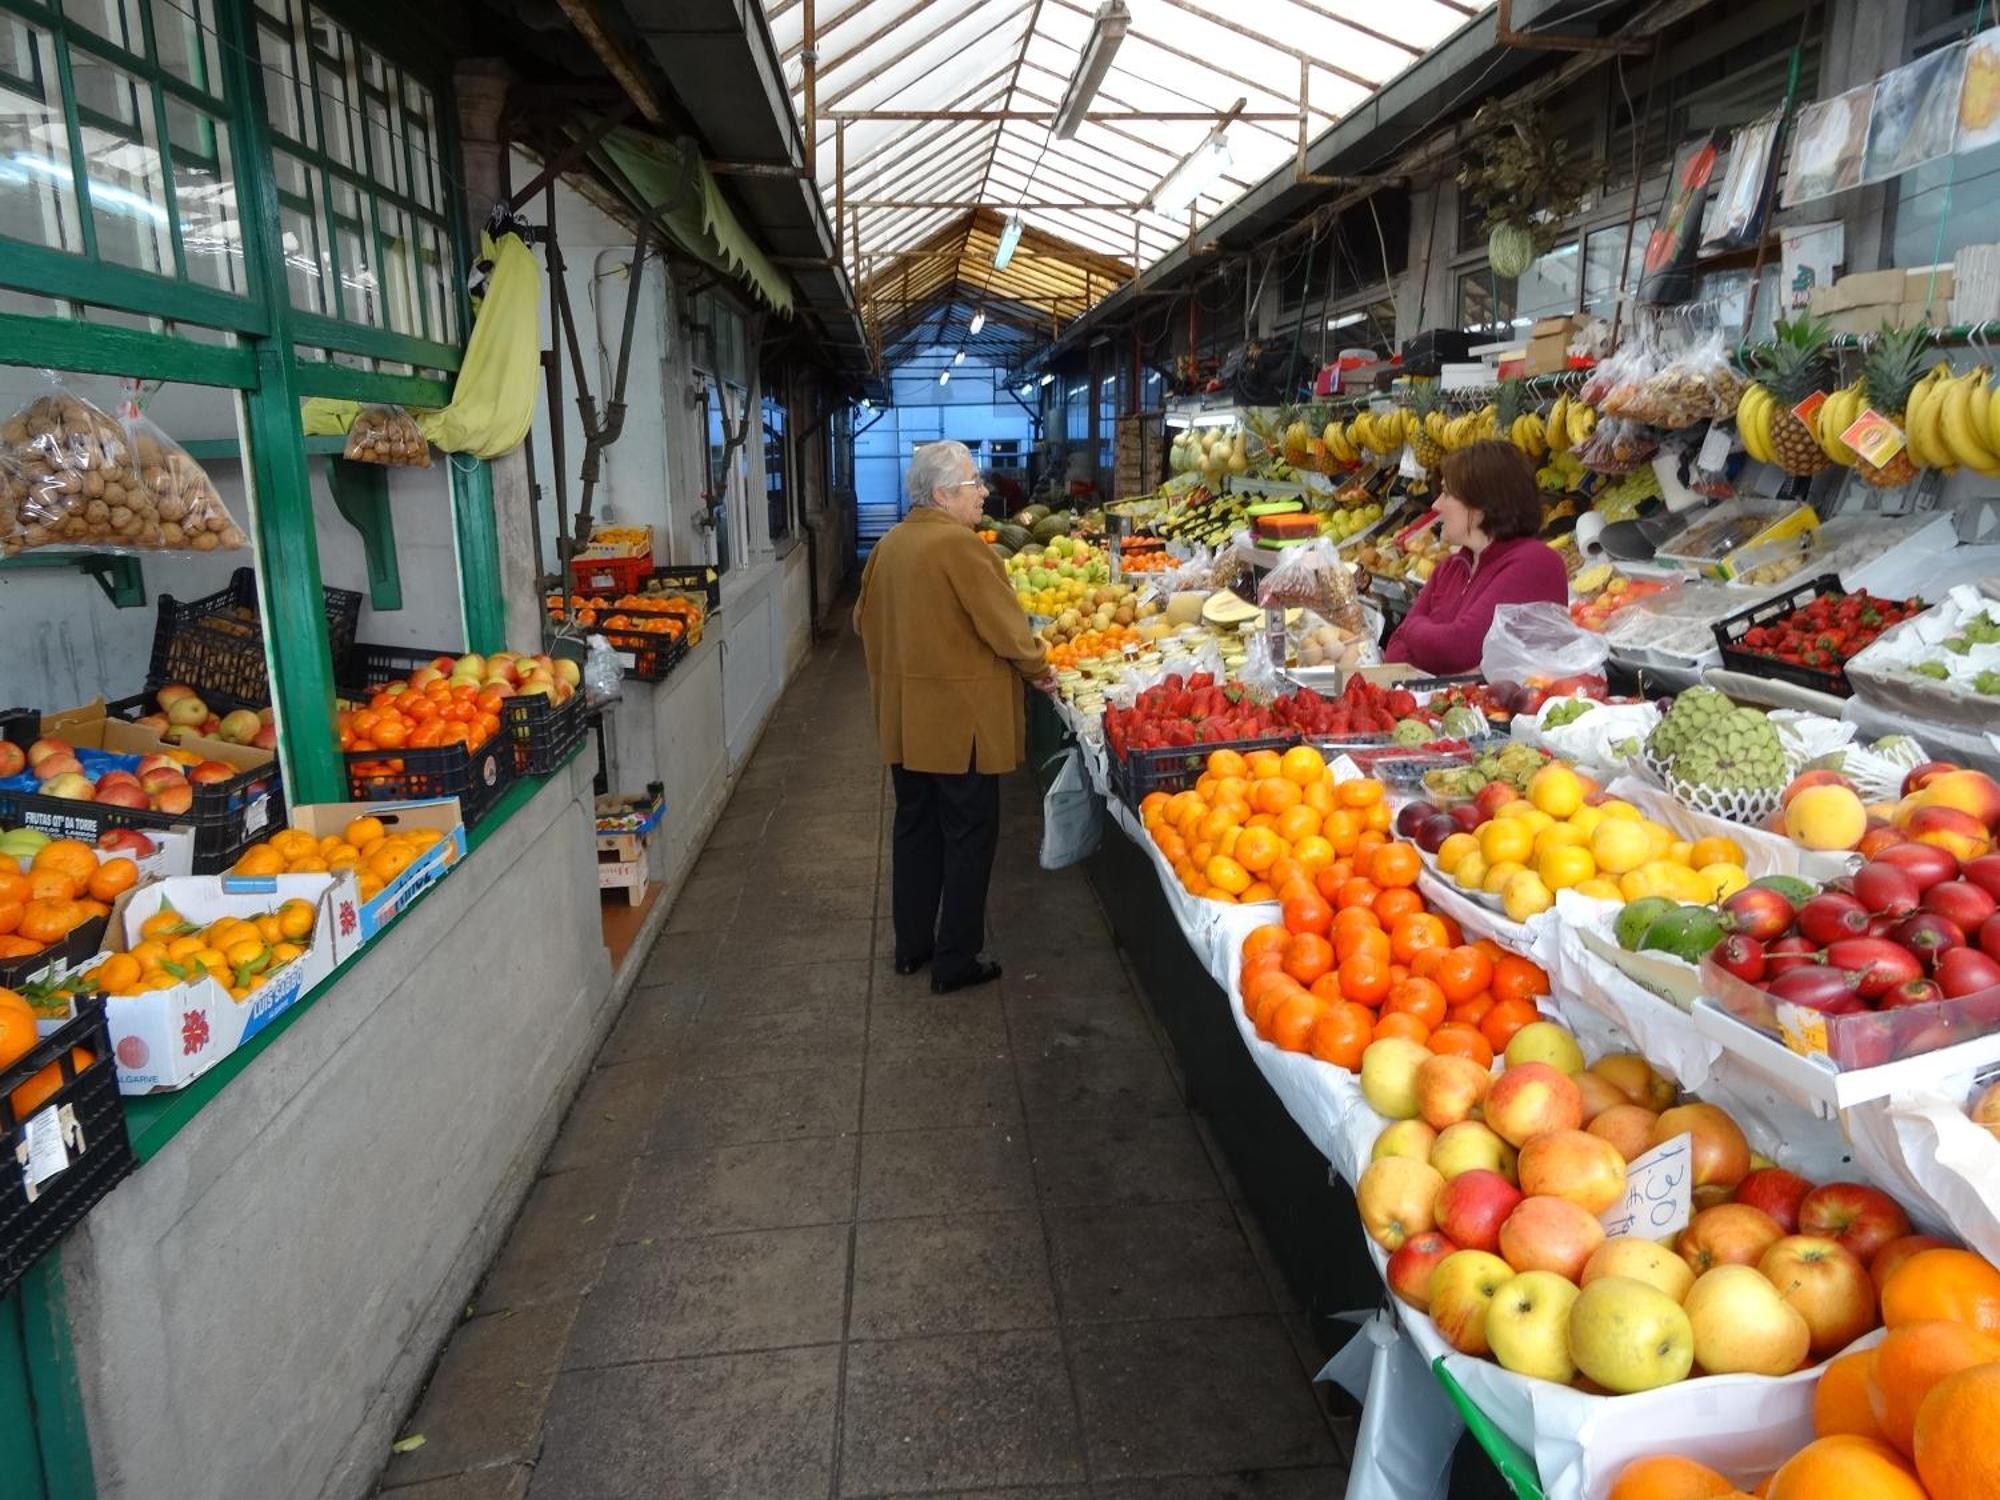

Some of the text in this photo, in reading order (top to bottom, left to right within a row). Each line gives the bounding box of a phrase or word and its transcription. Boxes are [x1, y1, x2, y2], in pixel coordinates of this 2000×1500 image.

[25, 811, 52, 826] FRUTAS
[65, 816, 75, 829] DA
[75, 818, 98, 832] TORRE
[254, 991, 273, 1019] LUIS
